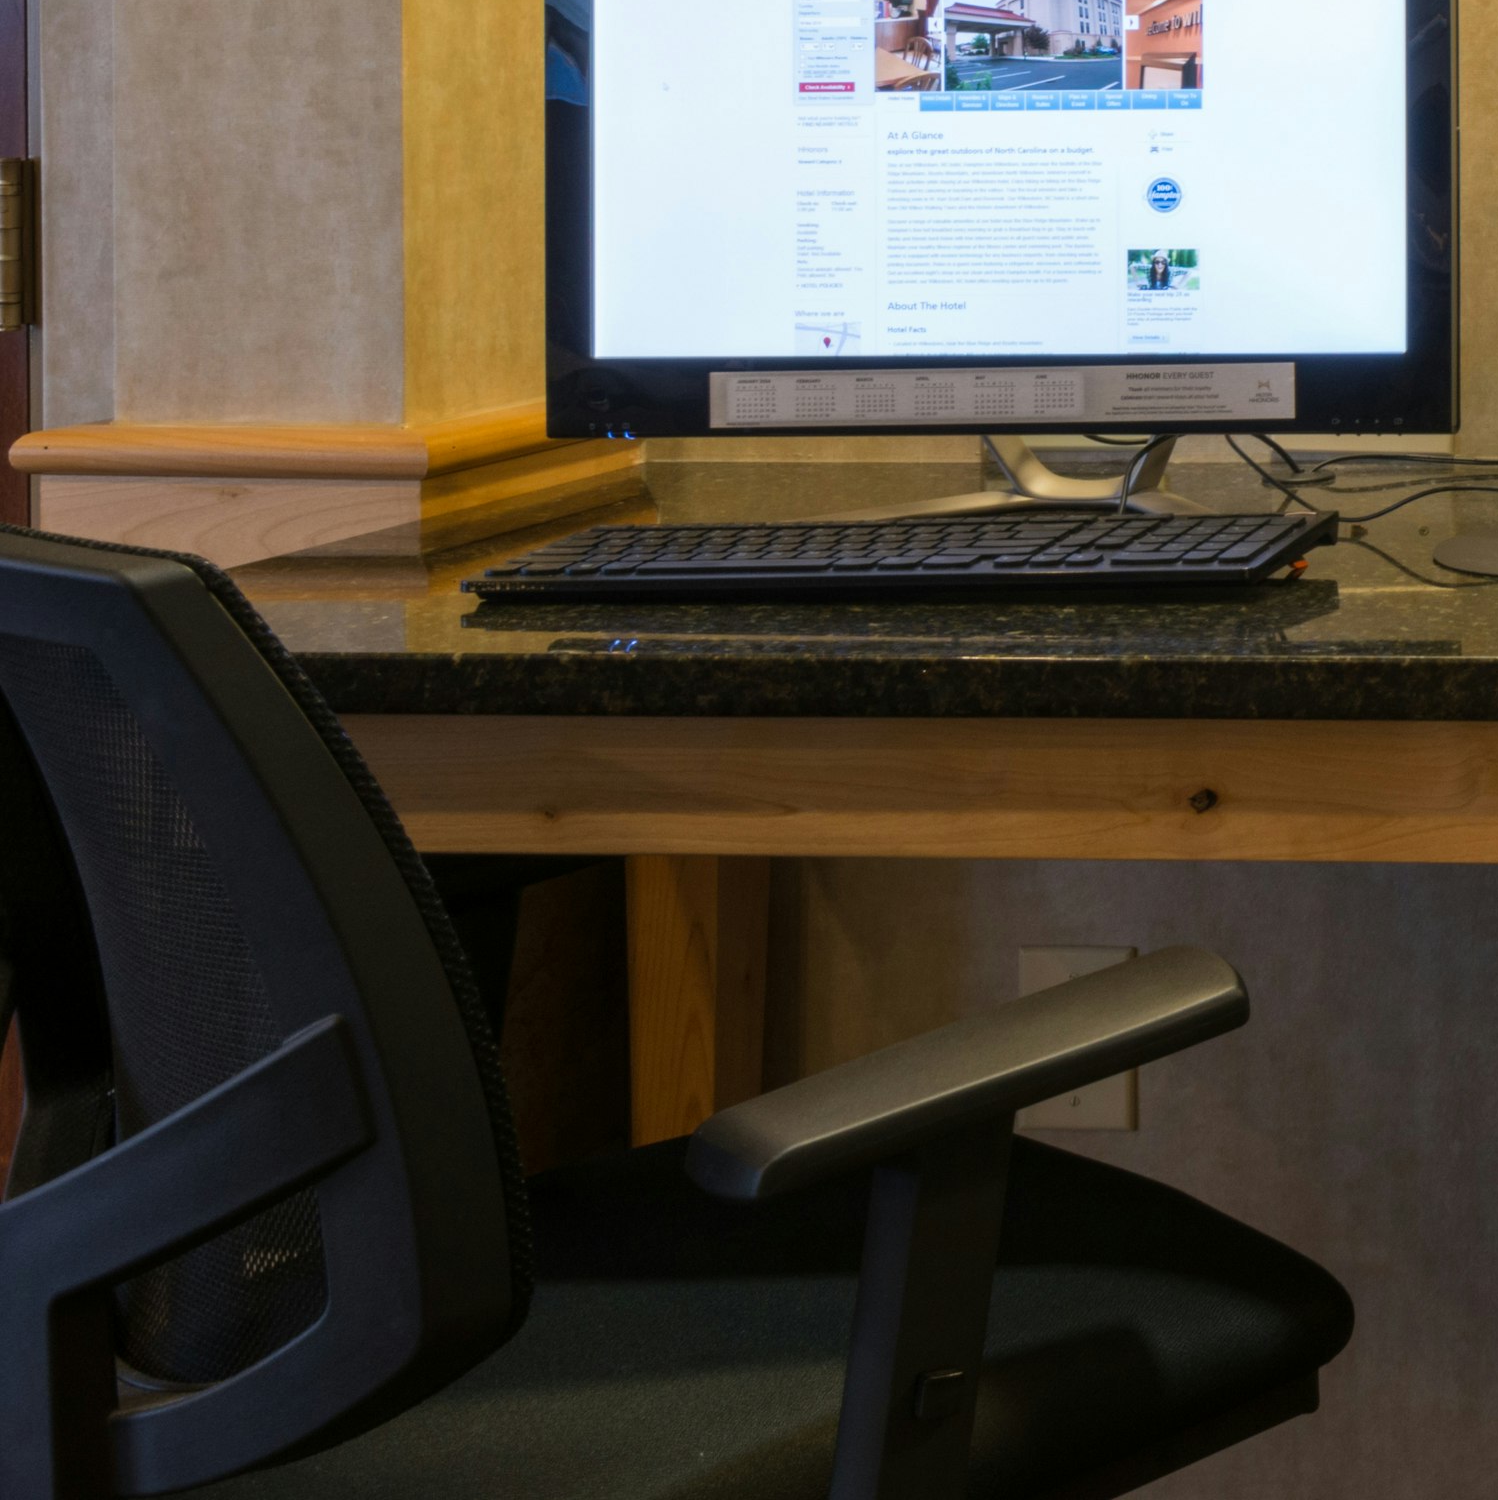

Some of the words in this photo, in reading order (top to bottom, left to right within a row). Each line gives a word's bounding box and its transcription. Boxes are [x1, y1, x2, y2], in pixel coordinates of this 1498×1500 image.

[888, 132, 898, 140] At
[912, 131, 943, 140] Glance
[888, 148, 914, 156] explore
[1066, 147, 1094, 155] budget.
[1148, 191, 1182, 201] Hampton
[888, 302, 916, 310] About
[921, 301, 937, 310] The
[940, 302, 966, 310] Hotel
[1126, 372, 1160, 380] HHONOR
[1163, 372, 1186, 380] EVERY
[1189, 371, 1213, 379] GUEST
